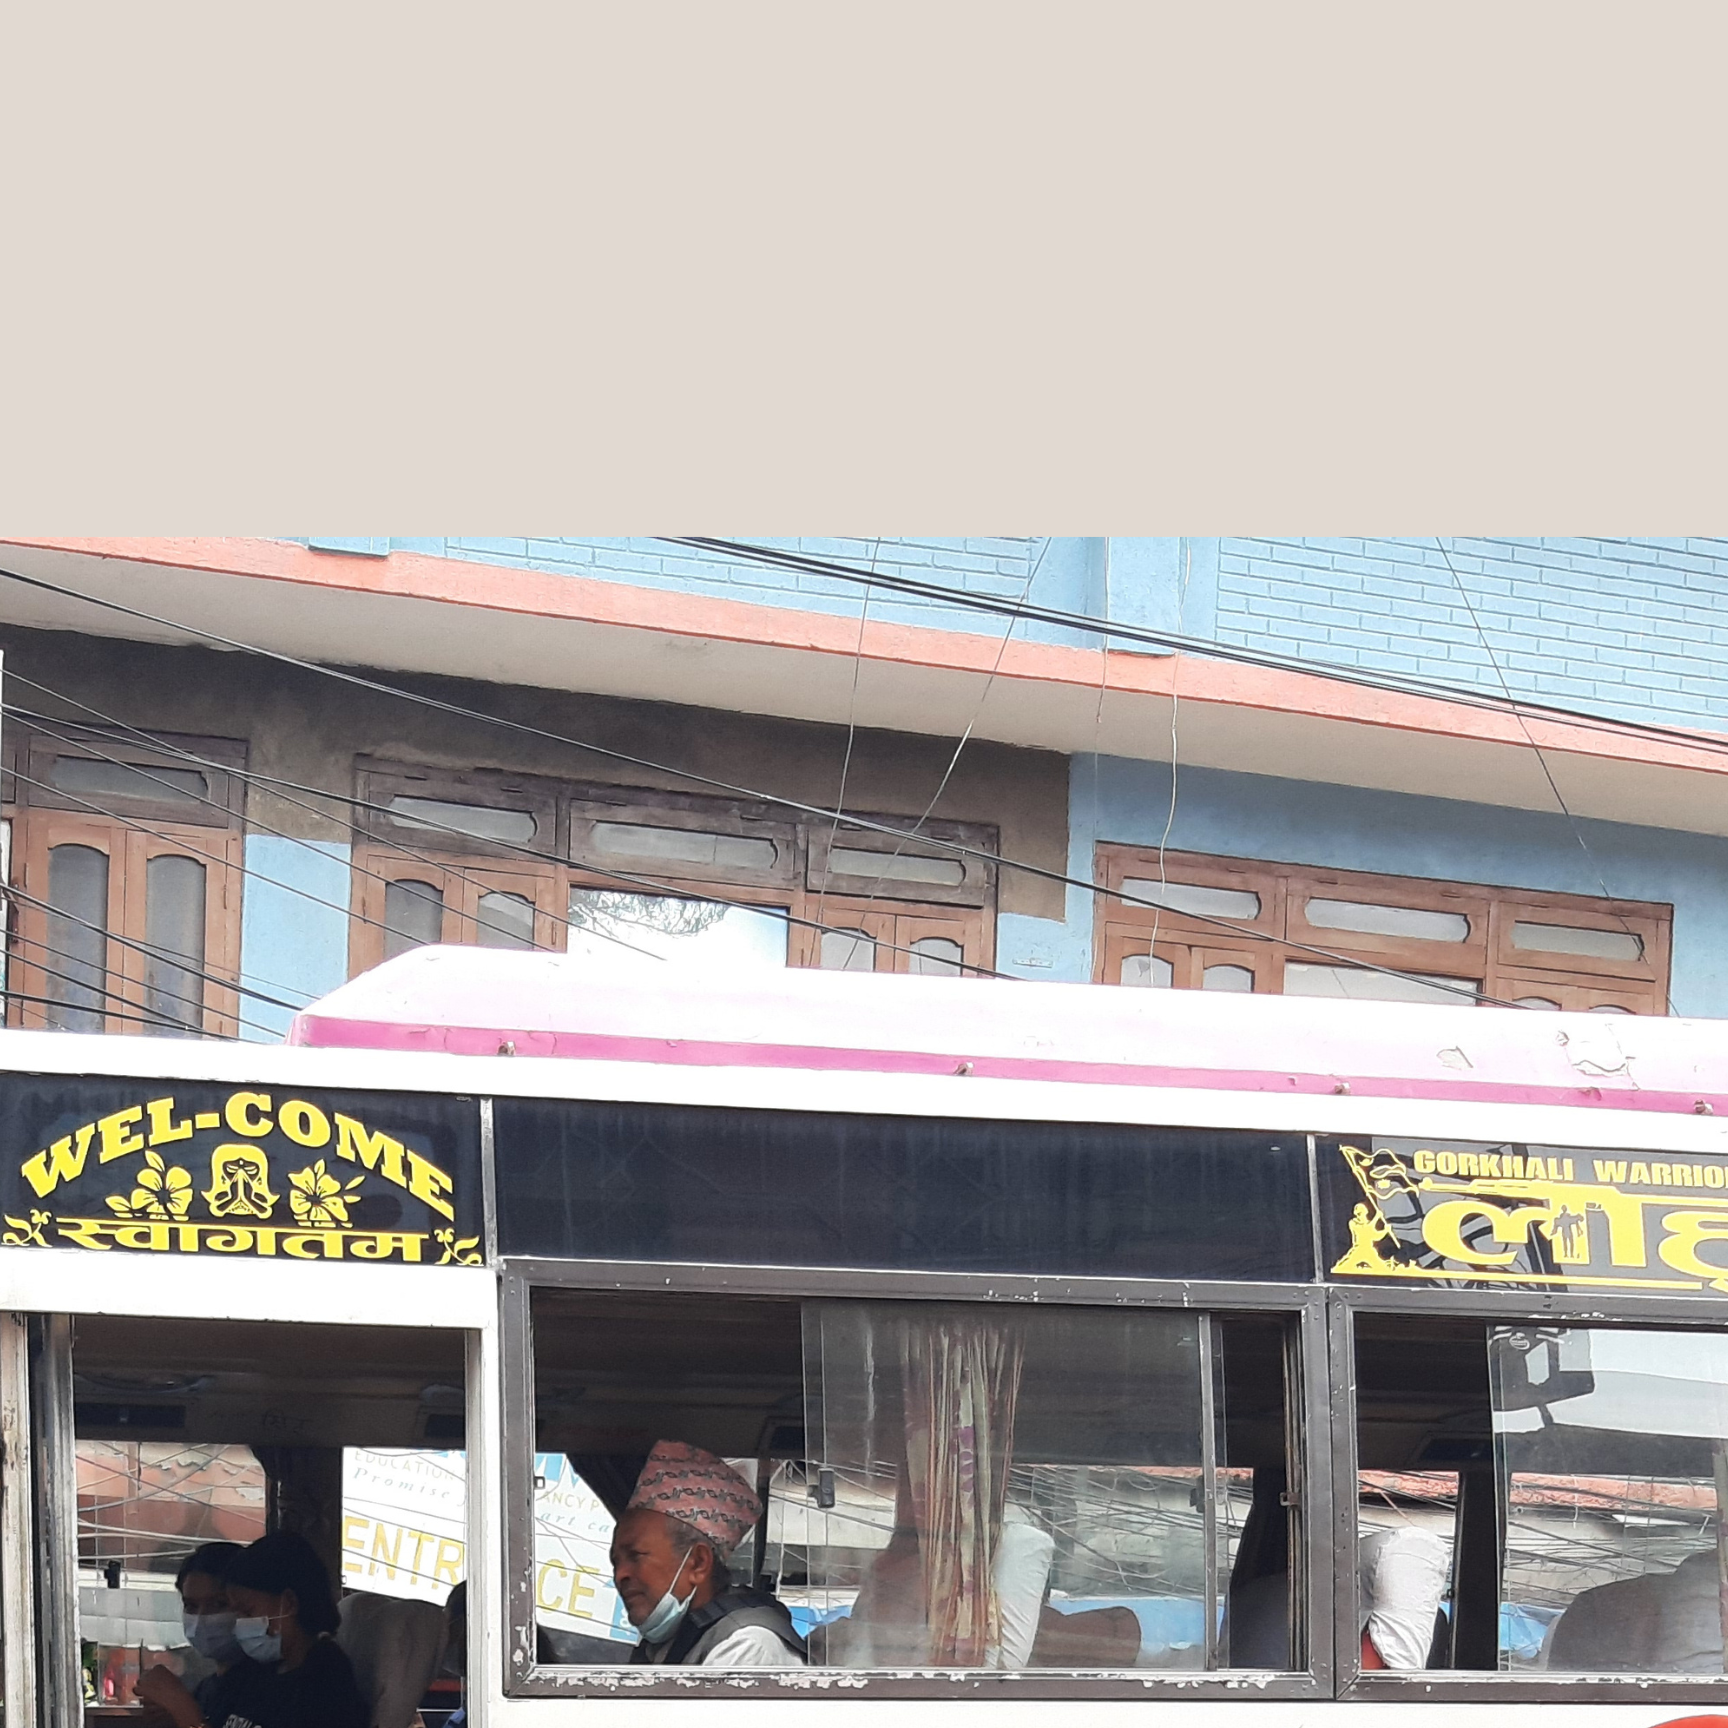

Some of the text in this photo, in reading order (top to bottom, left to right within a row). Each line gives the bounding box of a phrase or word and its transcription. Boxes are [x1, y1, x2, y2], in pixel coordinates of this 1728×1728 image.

[21, 1091, 456, 1222] WEL-COME
[1413, 1149, 1574, 1182] GORKHALI
[56, 1217, 430, 1263] स्वागतम
